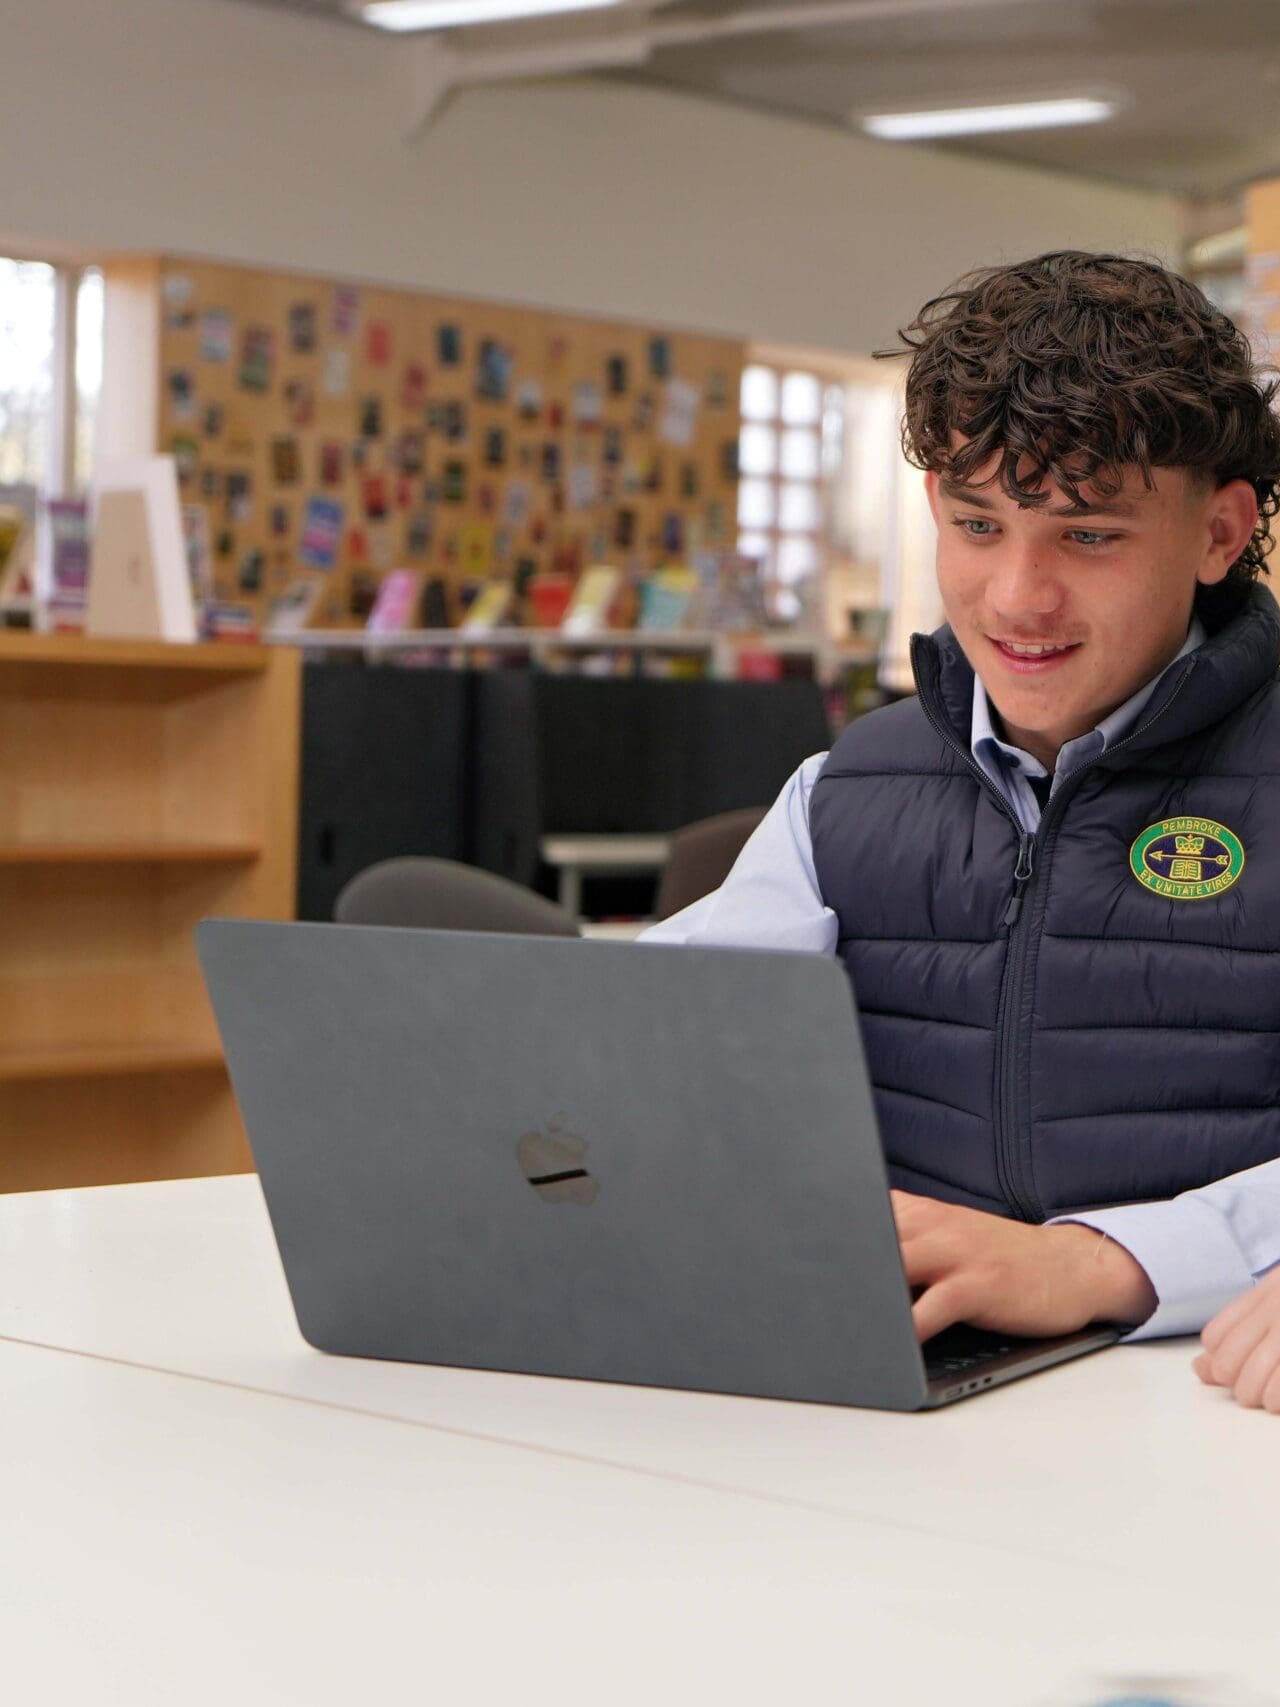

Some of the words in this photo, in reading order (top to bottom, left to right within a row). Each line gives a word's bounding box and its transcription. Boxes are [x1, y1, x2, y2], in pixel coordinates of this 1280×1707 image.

[1162, 820, 1221, 838] PEMBROKE
[1140, 869, 1152, 885] EX
[1156, 882, 1202, 896] UNITATE
[1206, 871, 1233, 893] VIRES
